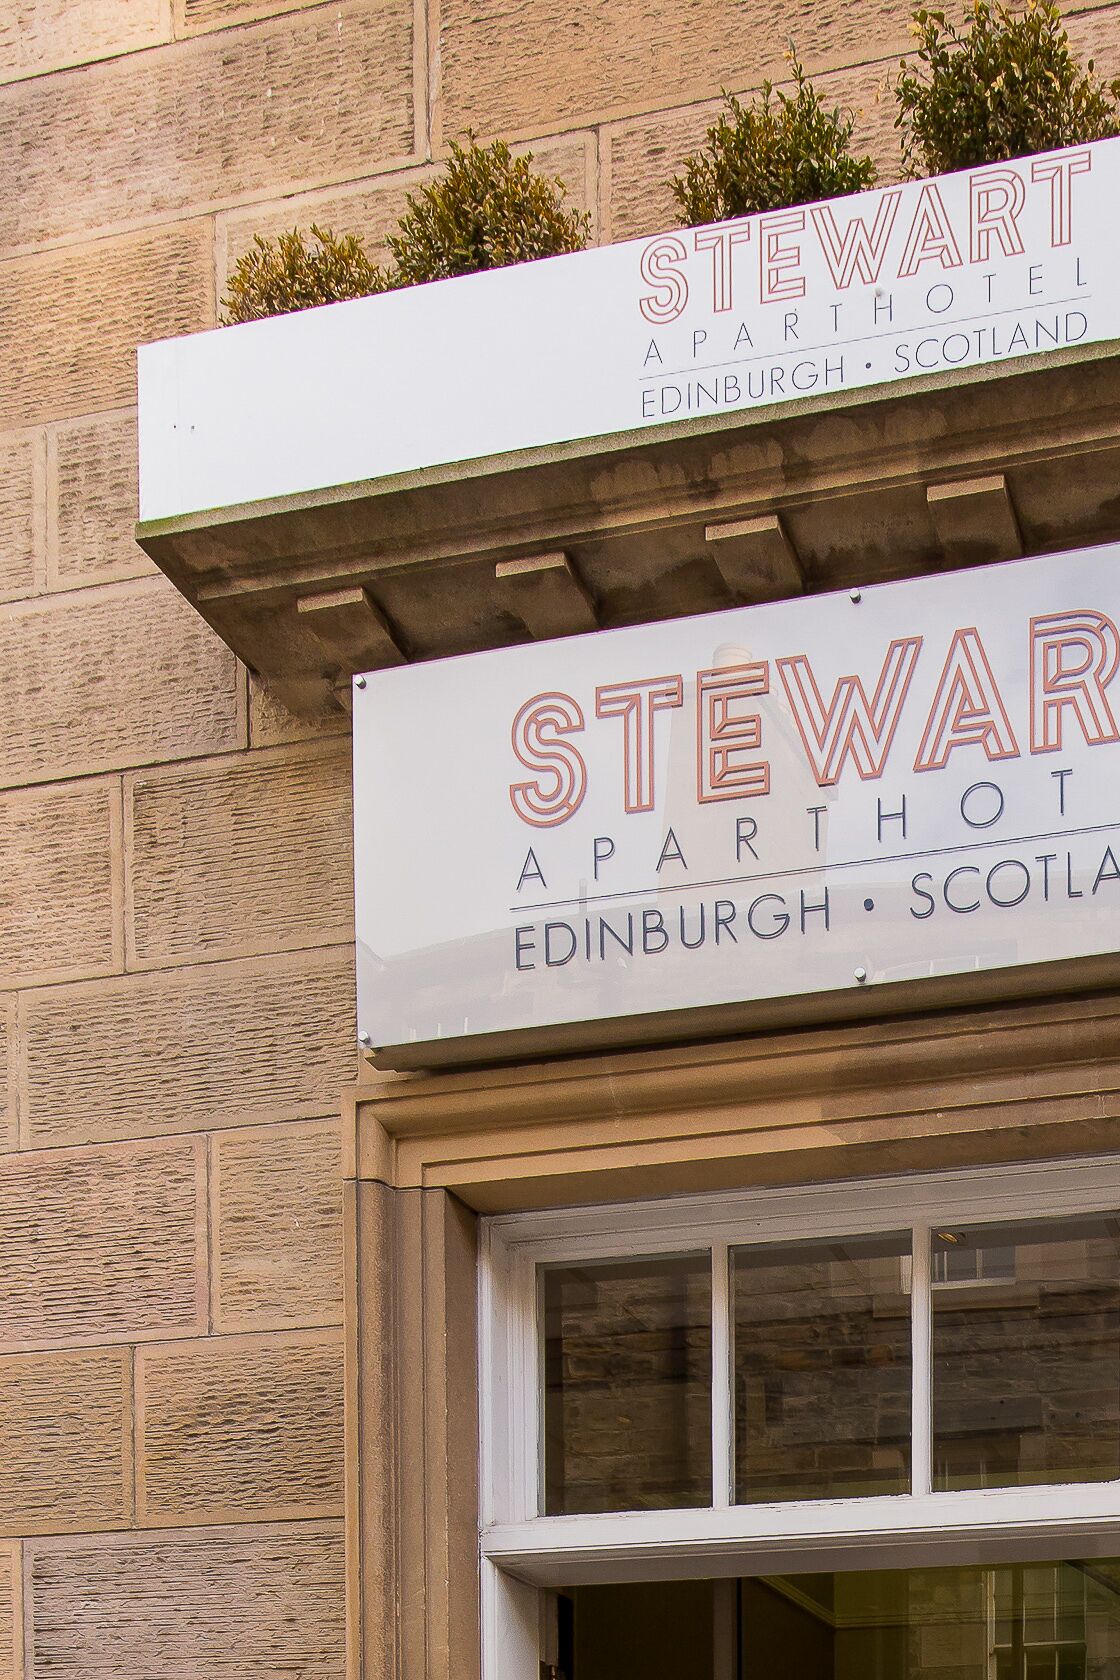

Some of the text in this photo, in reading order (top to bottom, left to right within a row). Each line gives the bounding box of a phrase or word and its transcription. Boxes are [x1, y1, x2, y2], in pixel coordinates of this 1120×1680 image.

[638, 150, 1092, 325] STEWART
[641, 311, 1089, 418] EDINBURGH SCOTLAND
[643, 257, 1088, 367] APARTHOTEL
[515, 886, 831, 971] EDINBURGH
